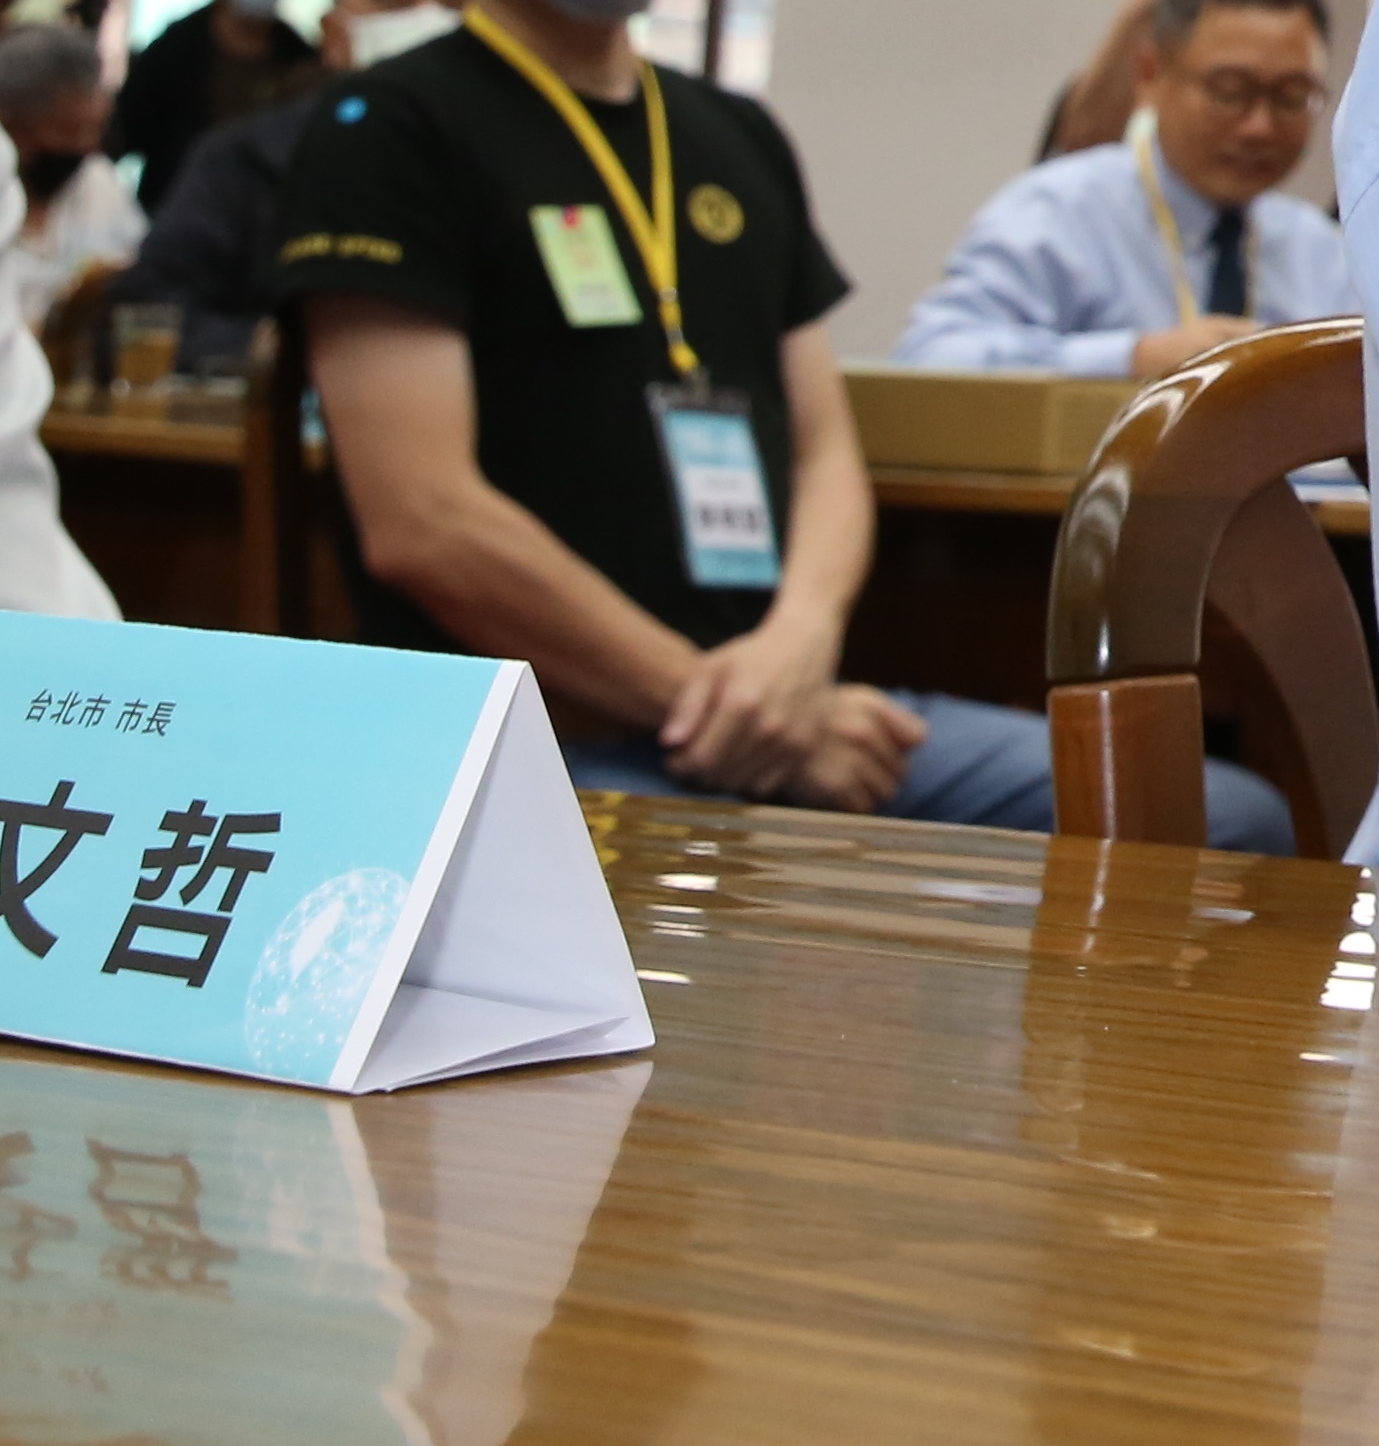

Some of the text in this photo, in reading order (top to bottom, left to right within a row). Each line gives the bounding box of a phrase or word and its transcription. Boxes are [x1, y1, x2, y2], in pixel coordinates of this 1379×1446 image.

[25, 689, 176, 736] 台北市 市長
